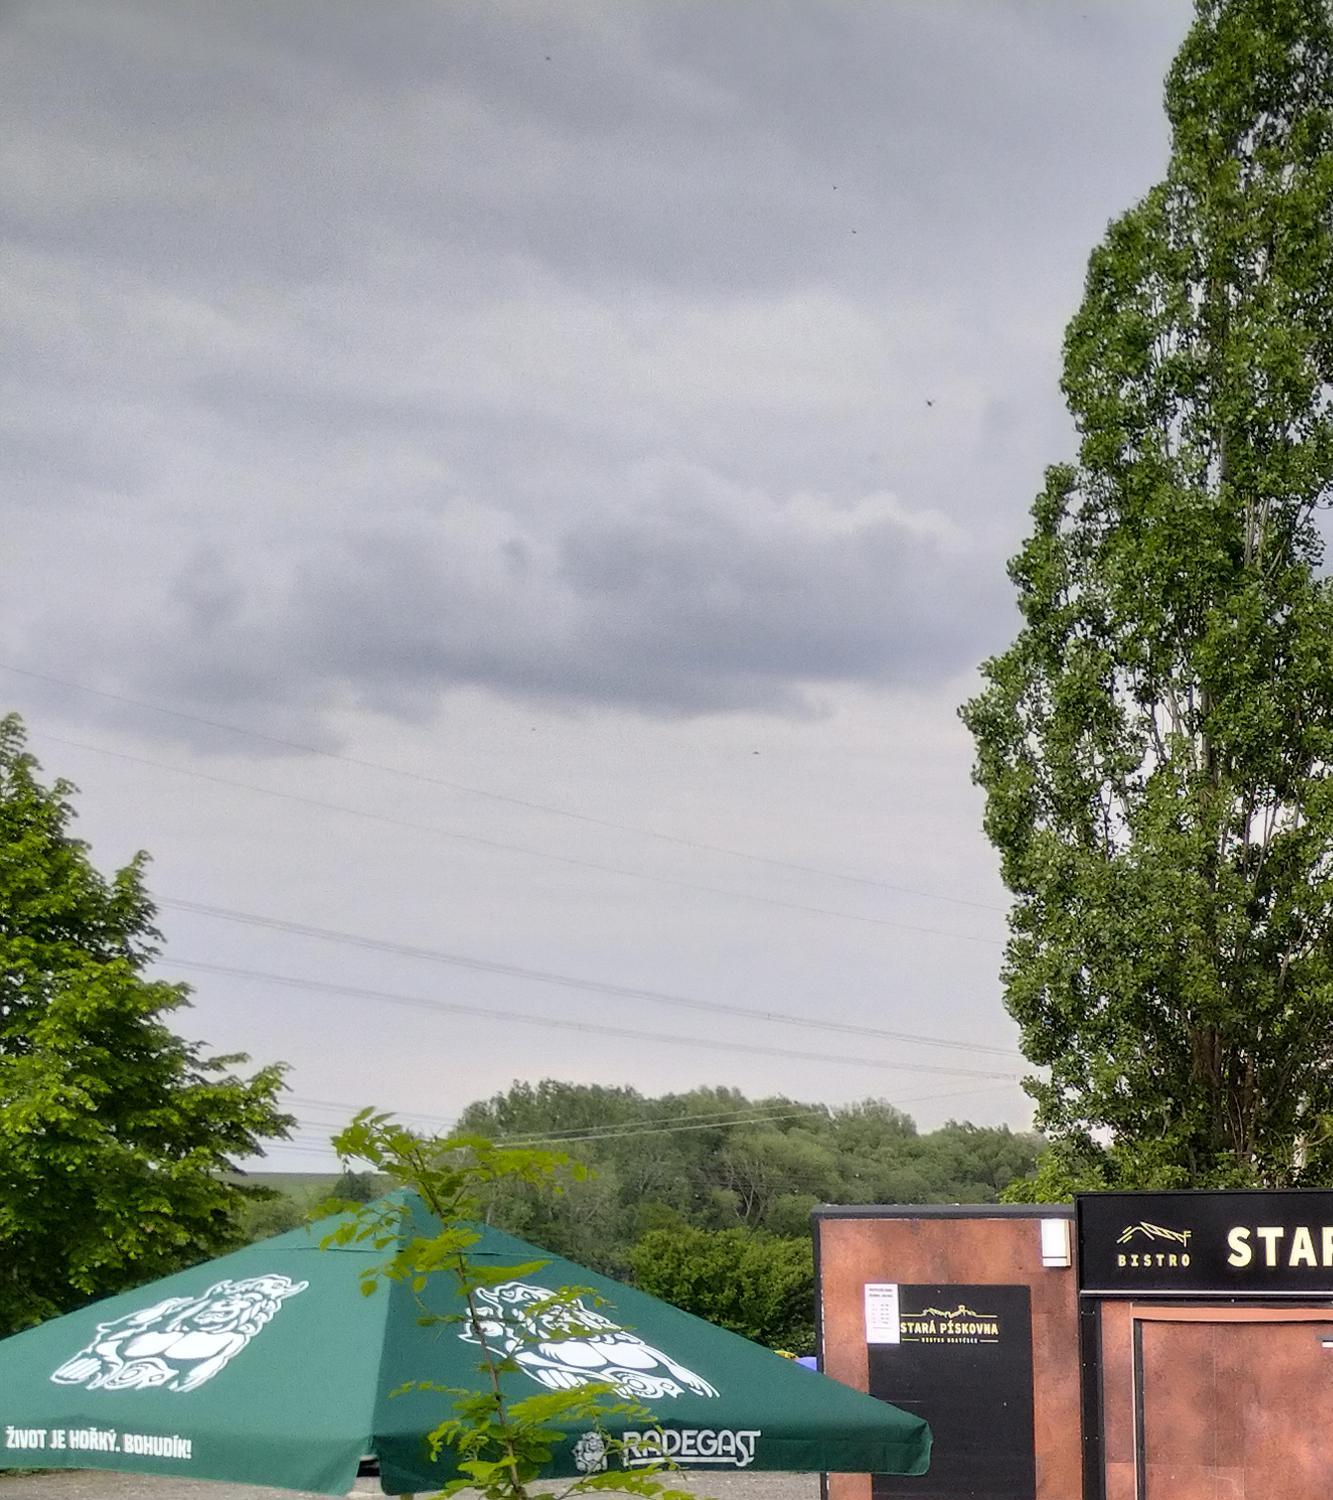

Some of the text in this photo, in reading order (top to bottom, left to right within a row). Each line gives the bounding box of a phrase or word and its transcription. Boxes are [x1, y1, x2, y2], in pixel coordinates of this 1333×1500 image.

[1117, 1253, 1191, 1268] BISTRO
[900, 1320, 999, 1335] STARÁ PÍSKOVNA
[5, 1425, 193, 1460] ŽIVOT JE HOŘKÝ. BOHUDÍK!
[622, 1429, 762, 1467] RADEGAST
